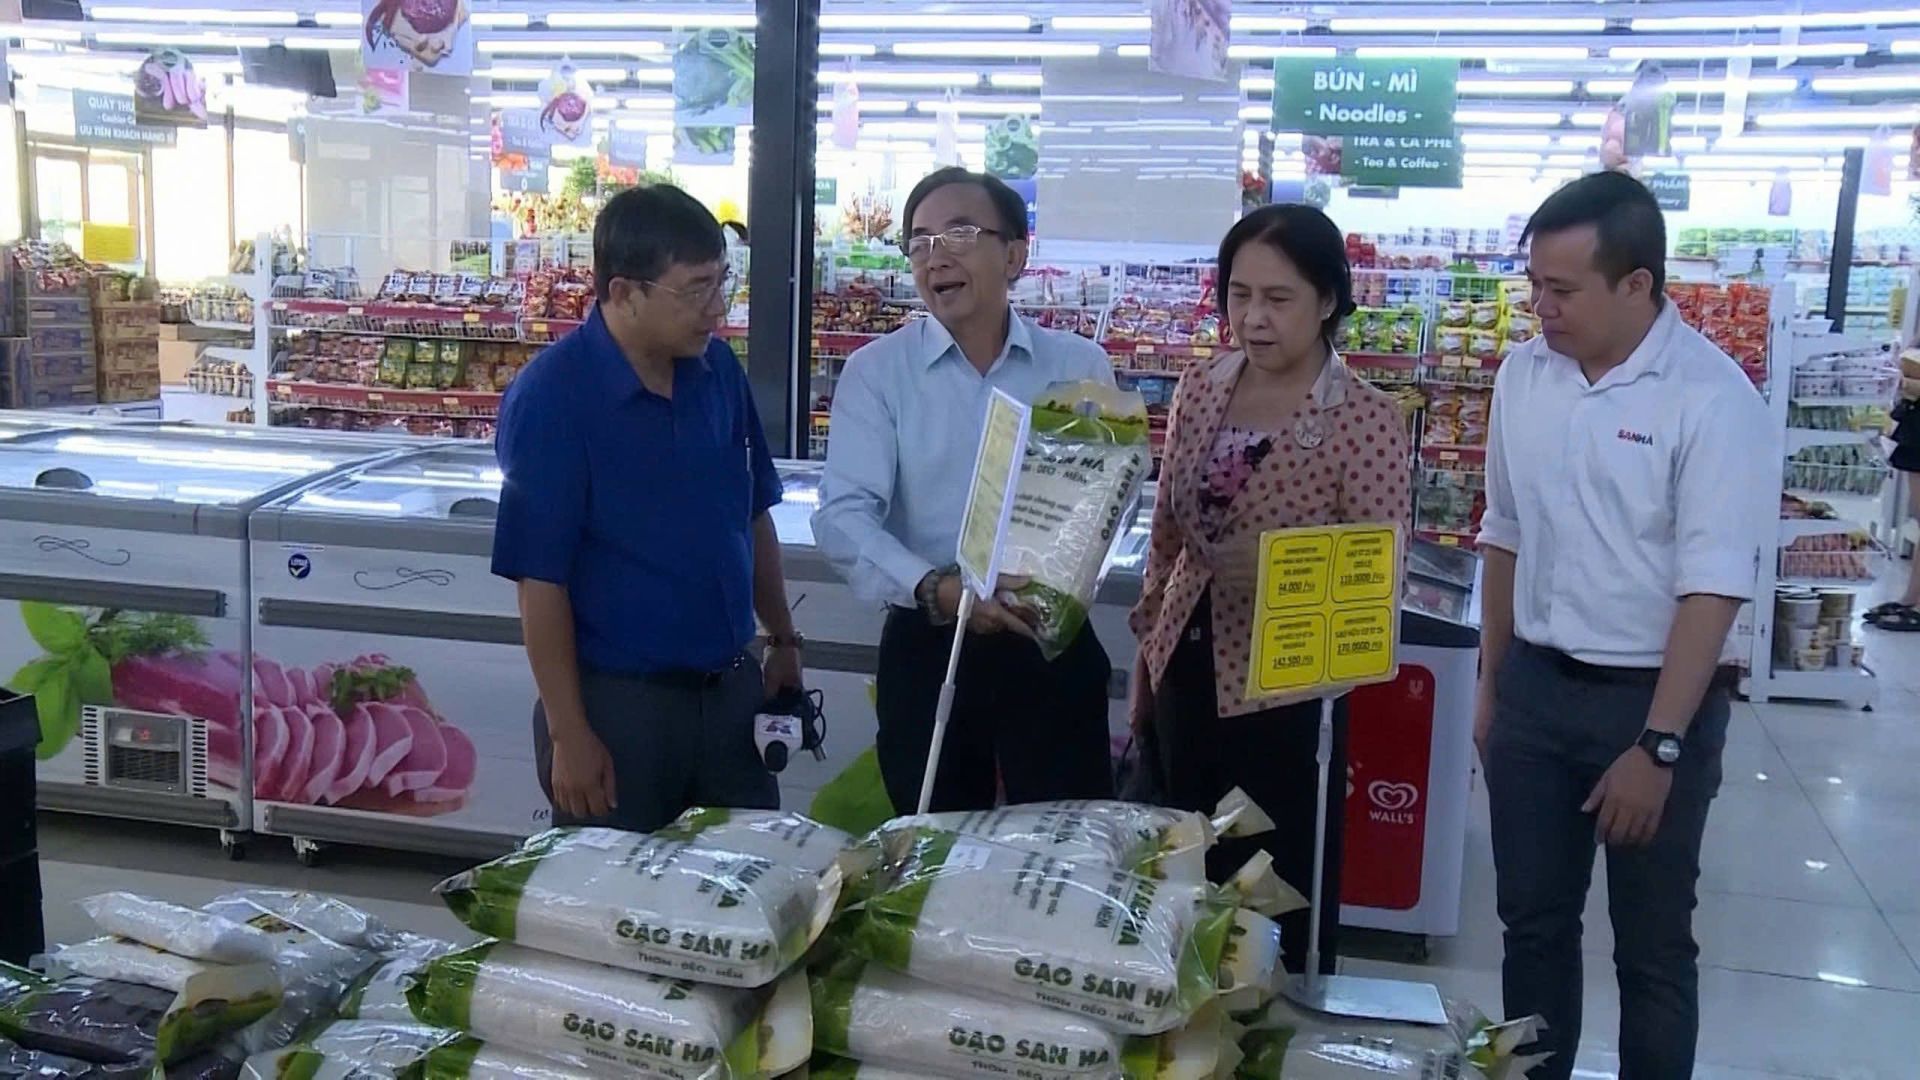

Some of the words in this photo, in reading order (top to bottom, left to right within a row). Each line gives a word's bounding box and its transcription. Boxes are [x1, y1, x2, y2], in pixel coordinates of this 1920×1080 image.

[1314, 68, 1364, 92] BÚN
[1388, 67, 1417, 92] MÌ
[1319, 103, 1407, 123] Noodles
[1363, 157, 1384, 167] Tea
[1387, 157, 1396, 167] &
[1401, 156, 1440, 169] Coffee
[1369, 810, 1414, 825] WALL'S
[680, 932, 731, 958] SAN
[1014, 957, 1072, 985] GẠO
[1082, 973, 1136, 1000] SAN
[563, 1013, 615, 1040] GẠO
[624, 1028, 675, 1056] SAN
[949, 1026, 1006, 1053] GẠO
[1016, 1039, 1068, 1065] SAN
